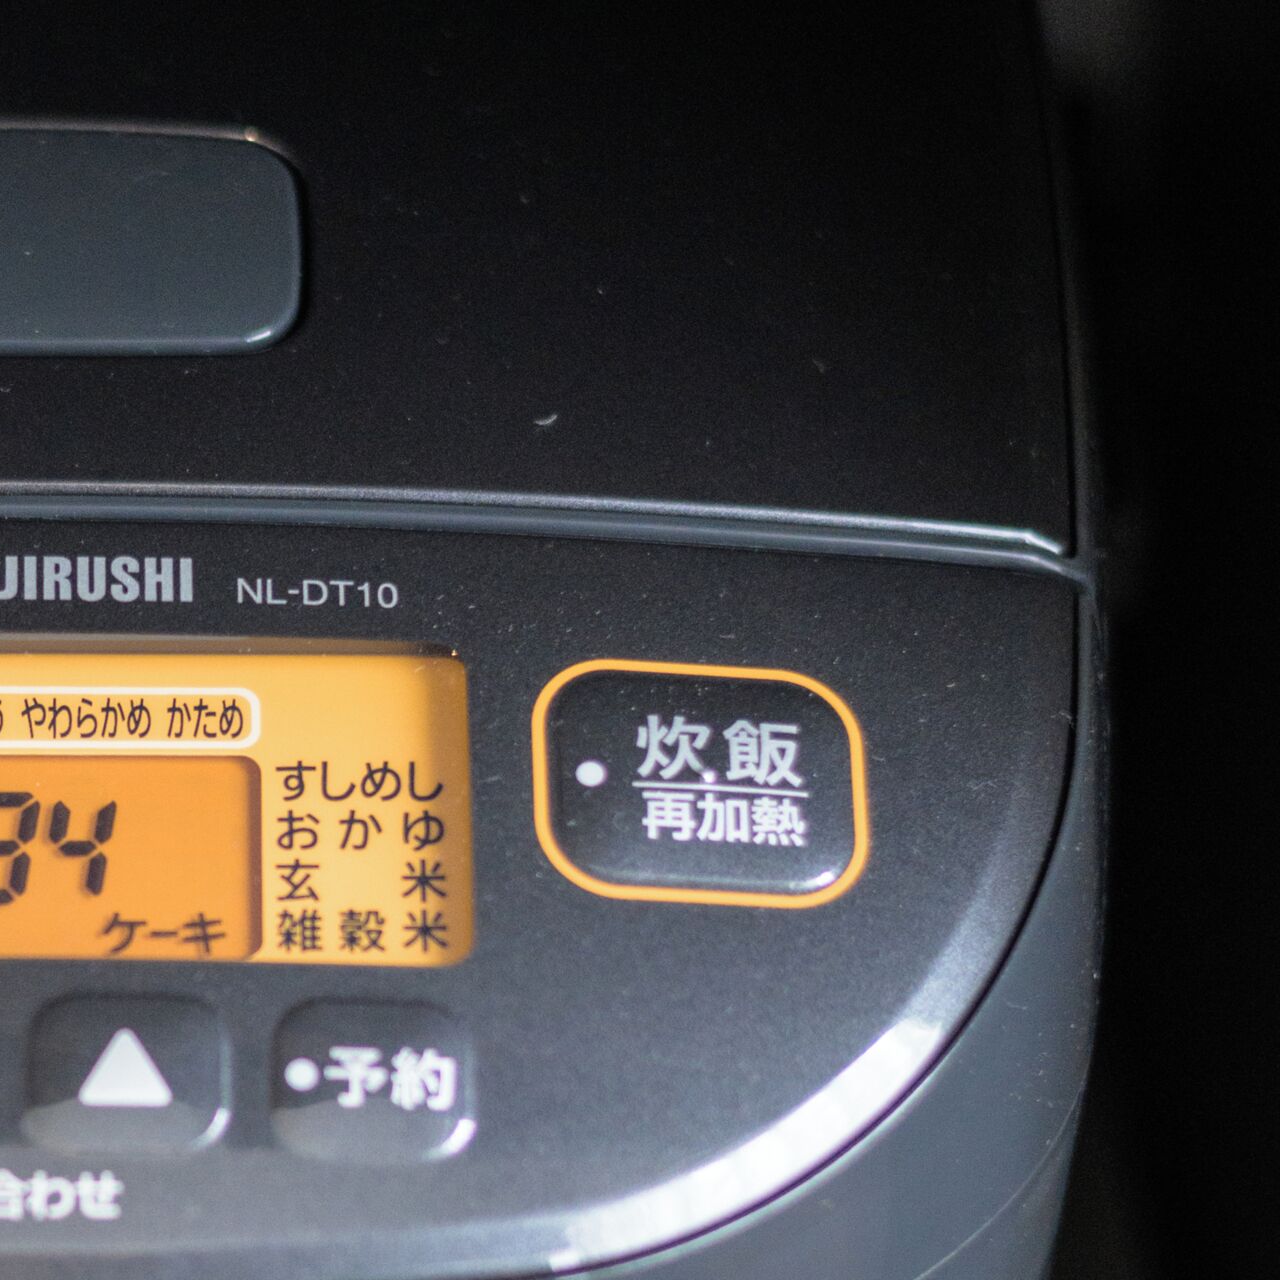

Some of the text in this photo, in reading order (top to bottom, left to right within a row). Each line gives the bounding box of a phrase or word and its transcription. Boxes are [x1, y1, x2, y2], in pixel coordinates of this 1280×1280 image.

[236, 578, 400, 608] NL-DT10
[21, 698, 152, 738] やわらかめ
[166, 699, 245, 738] かため
[634, 715, 802, 788] 炊飯
[275, 760, 445, 803] すしめし
[276, 809, 446, 851] おかゆ
[641, 793, 807, 847] 再加熱
[99, 911, 227, 957] ケーキ
[276, 908, 449, 954] 雑穀米
[323, 1046, 458, 1111] 予約
